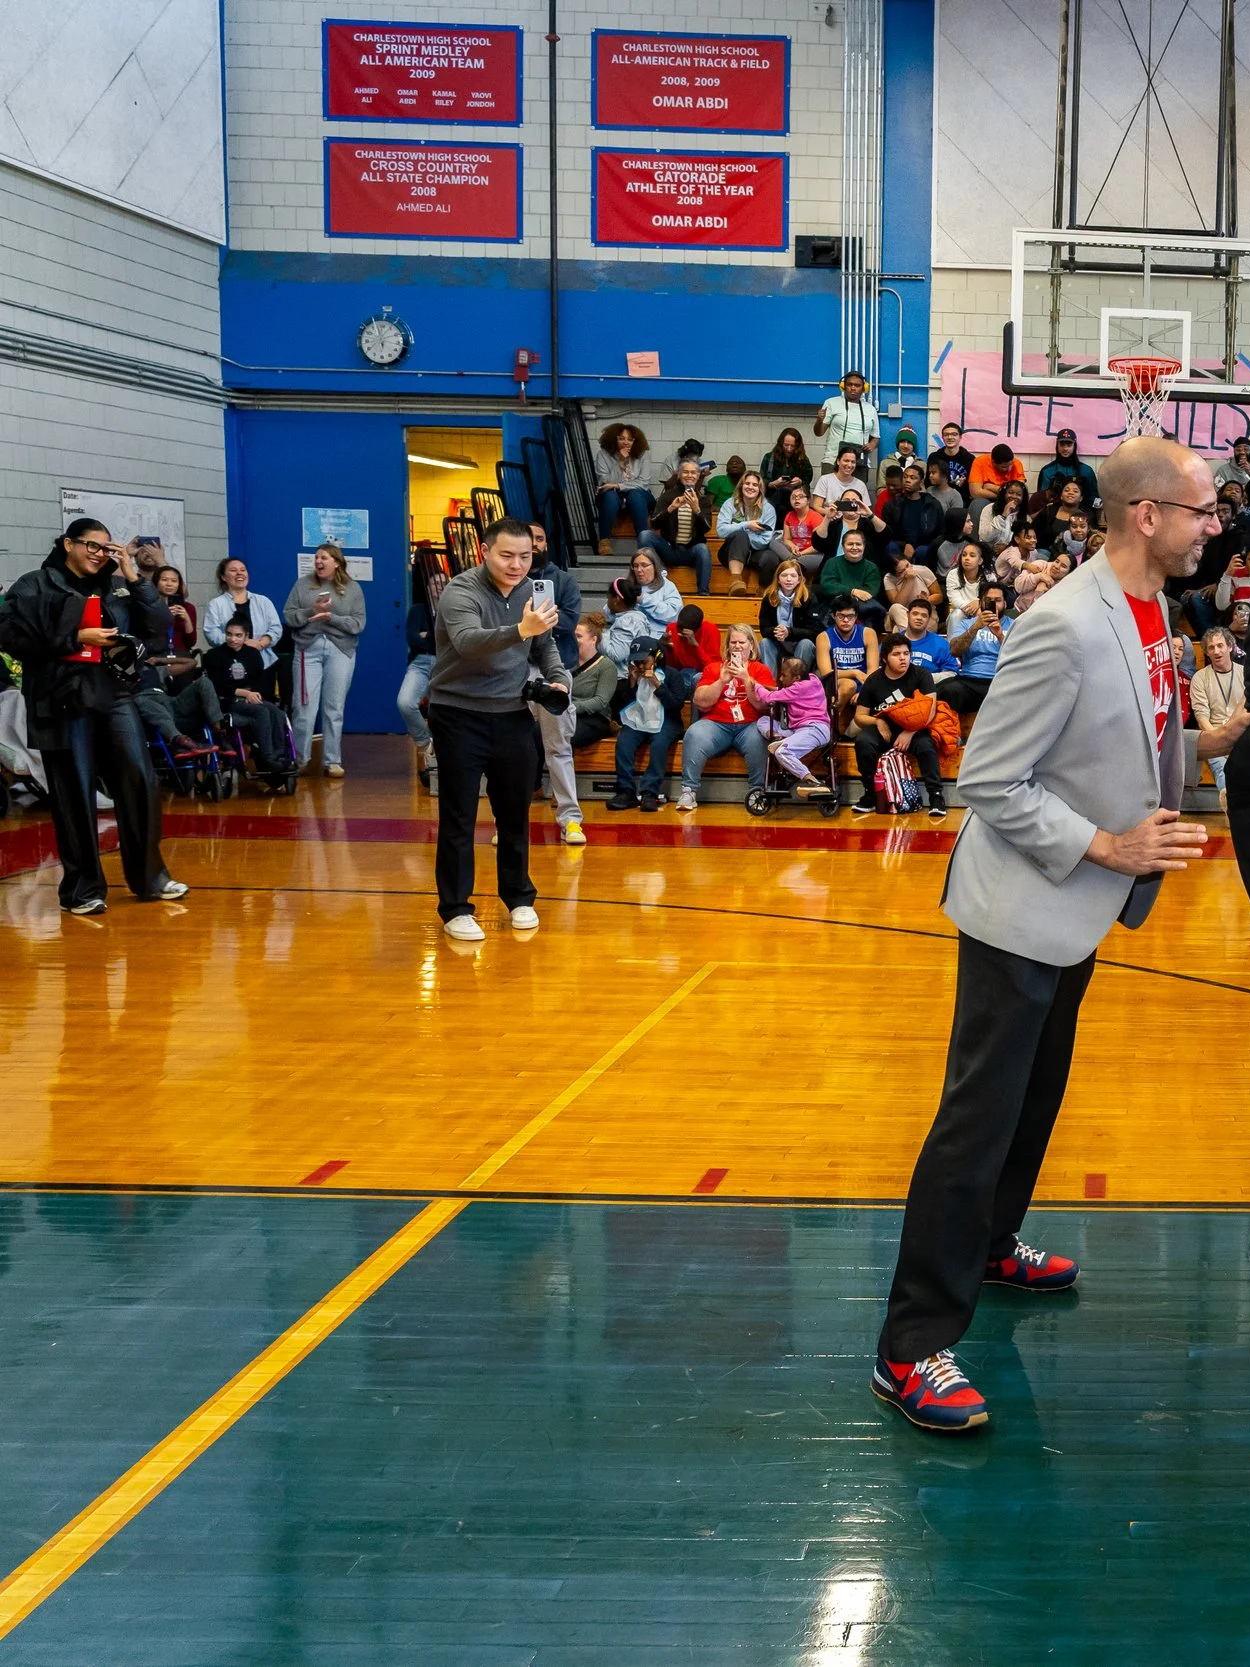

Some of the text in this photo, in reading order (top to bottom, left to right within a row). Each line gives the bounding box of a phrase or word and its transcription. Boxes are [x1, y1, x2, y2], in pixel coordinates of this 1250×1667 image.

[353, 33, 492, 47] CHARLESTOWN HIGH SCHOOL
[375, 43, 470, 57] SPRINT MEDLEY
[622, 43, 760, 56] CHARLESTOWN HIGH SCHOOL
[360, 55, 485, 69] ALL AMERICAN TEAM
[611, 54, 770, 69] ALL-AMERICAN TRACK & FIELD
[409, 69, 436, 79] 2009
[660, 76, 720, 87] 2008, 2009
[354, 87, 379, 95] AHMED
[432, 90, 457, 98] KAMAL
[652, 96, 728, 109] OMAR ABDI
[355, 150, 492, 163] CHARLESTOWN HIGH SCHOOL
[370, 160, 478, 174] CROSS COUNTRY
[622, 160, 759, 173] CHARLESTOWN HIGH SCHOOL
[361, 172, 489, 186] ALL STATE CHAMPION
[654, 171, 726, 184] GATORADE
[410, 186, 437, 196] 2008
[626, 182, 754, 196] ATHLETE OF THE YEAR
[677, 196, 703, 205] 2008
[396, 203, 451, 213] AHMED ALI
[651, 215, 728, 229] OMAR ABDI
[63, 491, 79, 500] Date:
[63, 506, 85, 515] Agenda:
